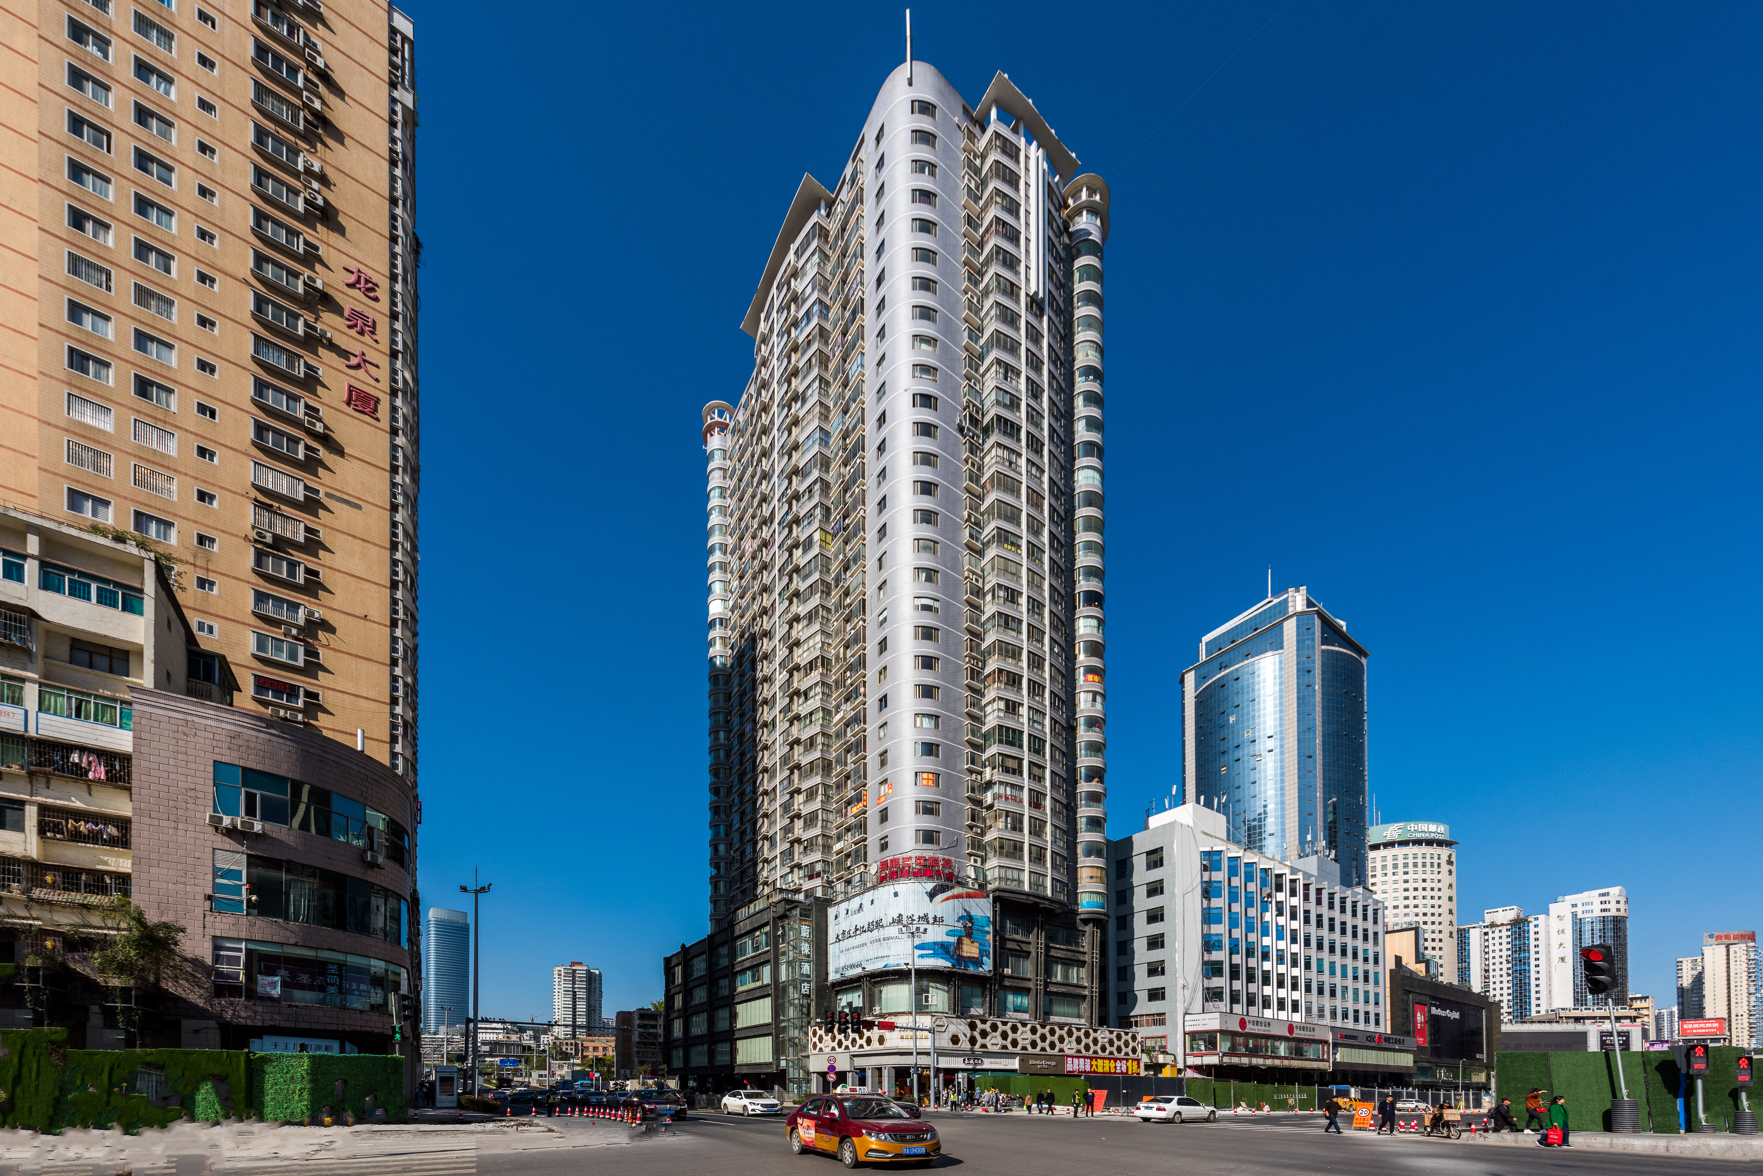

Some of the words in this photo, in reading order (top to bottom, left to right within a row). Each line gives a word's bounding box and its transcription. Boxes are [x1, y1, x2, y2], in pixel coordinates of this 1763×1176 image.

[342, 265, 379, 421] 龙泉大厦
[1407, 823, 1445, 834] 中国邮政
